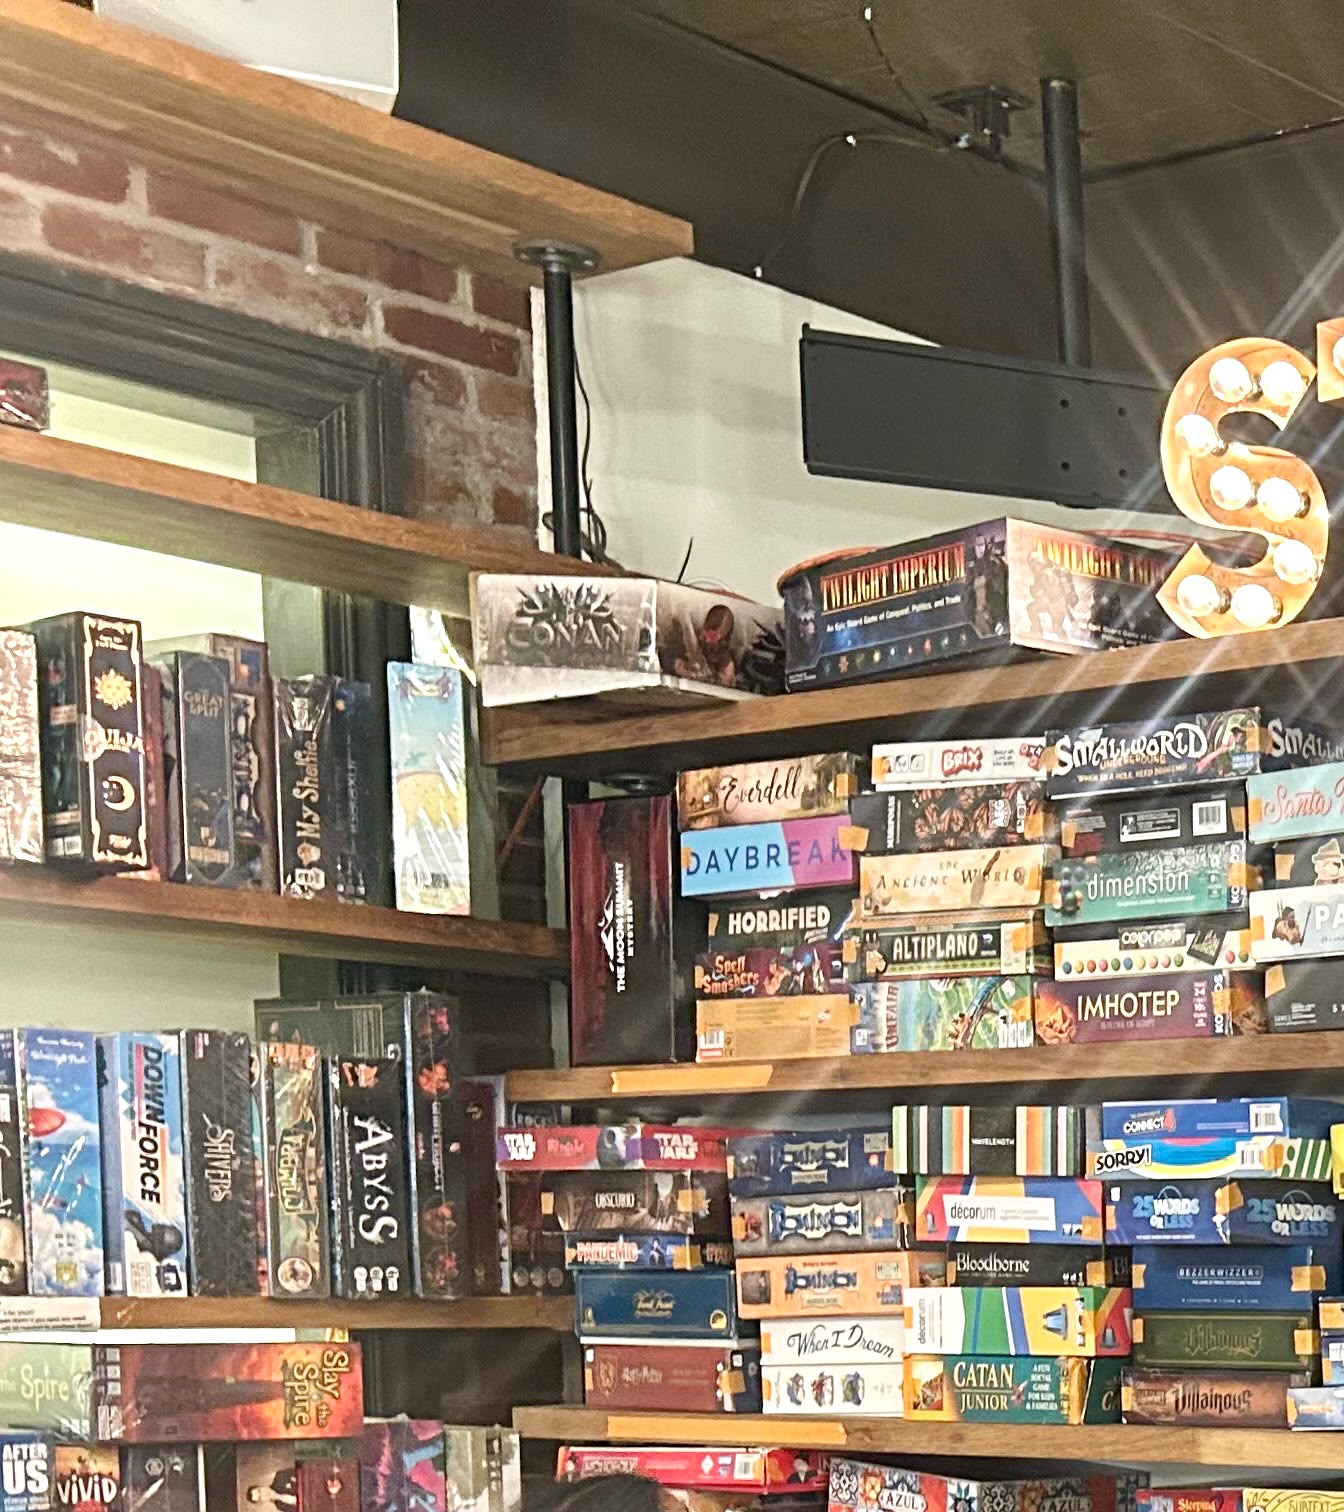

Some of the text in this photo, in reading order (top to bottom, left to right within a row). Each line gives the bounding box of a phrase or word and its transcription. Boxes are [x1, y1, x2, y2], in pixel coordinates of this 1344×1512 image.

[821, 544, 965, 611] TWILIGHT IMPERIUM
[507, 622, 626, 654] CONAN
[941, 746, 983, 777] BRIX
[294, 738, 321, 839] My Shelfie
[719, 764, 801, 814] Everdell
[1263, 788, 1332, 825] Santa
[685, 840, 848, 877] DAYBREAK
[1087, 868, 1189, 901] dimension
[728, 905, 832, 935] HORRIFIED
[893, 932, 978, 962] ALTIPLANO
[1077, 990, 1180, 1022] IMHOTEP
[137, 1042, 163, 1205] DOWNFORCE
[1096, 1148, 1151, 1171] SORRY!
[353, 1114, 400, 1247] ABYSS
[950, 1203, 996, 1221] décorum
[956, 1253, 1031, 1274] Bloodborne
[21, 1365, 70, 1402] Spire
[315, 1350, 350, 1427] Slay the
[953, 1362, 1014, 1389] CATAN
[290, 1361, 317, 1427] Spire
[959, 1393, 1009, 1412] JUNIOR
[1, 1444, 47, 1463] AFTER
[1, 1464, 49, 1495] US
[884, 1494, 919, 1511] AZUL
